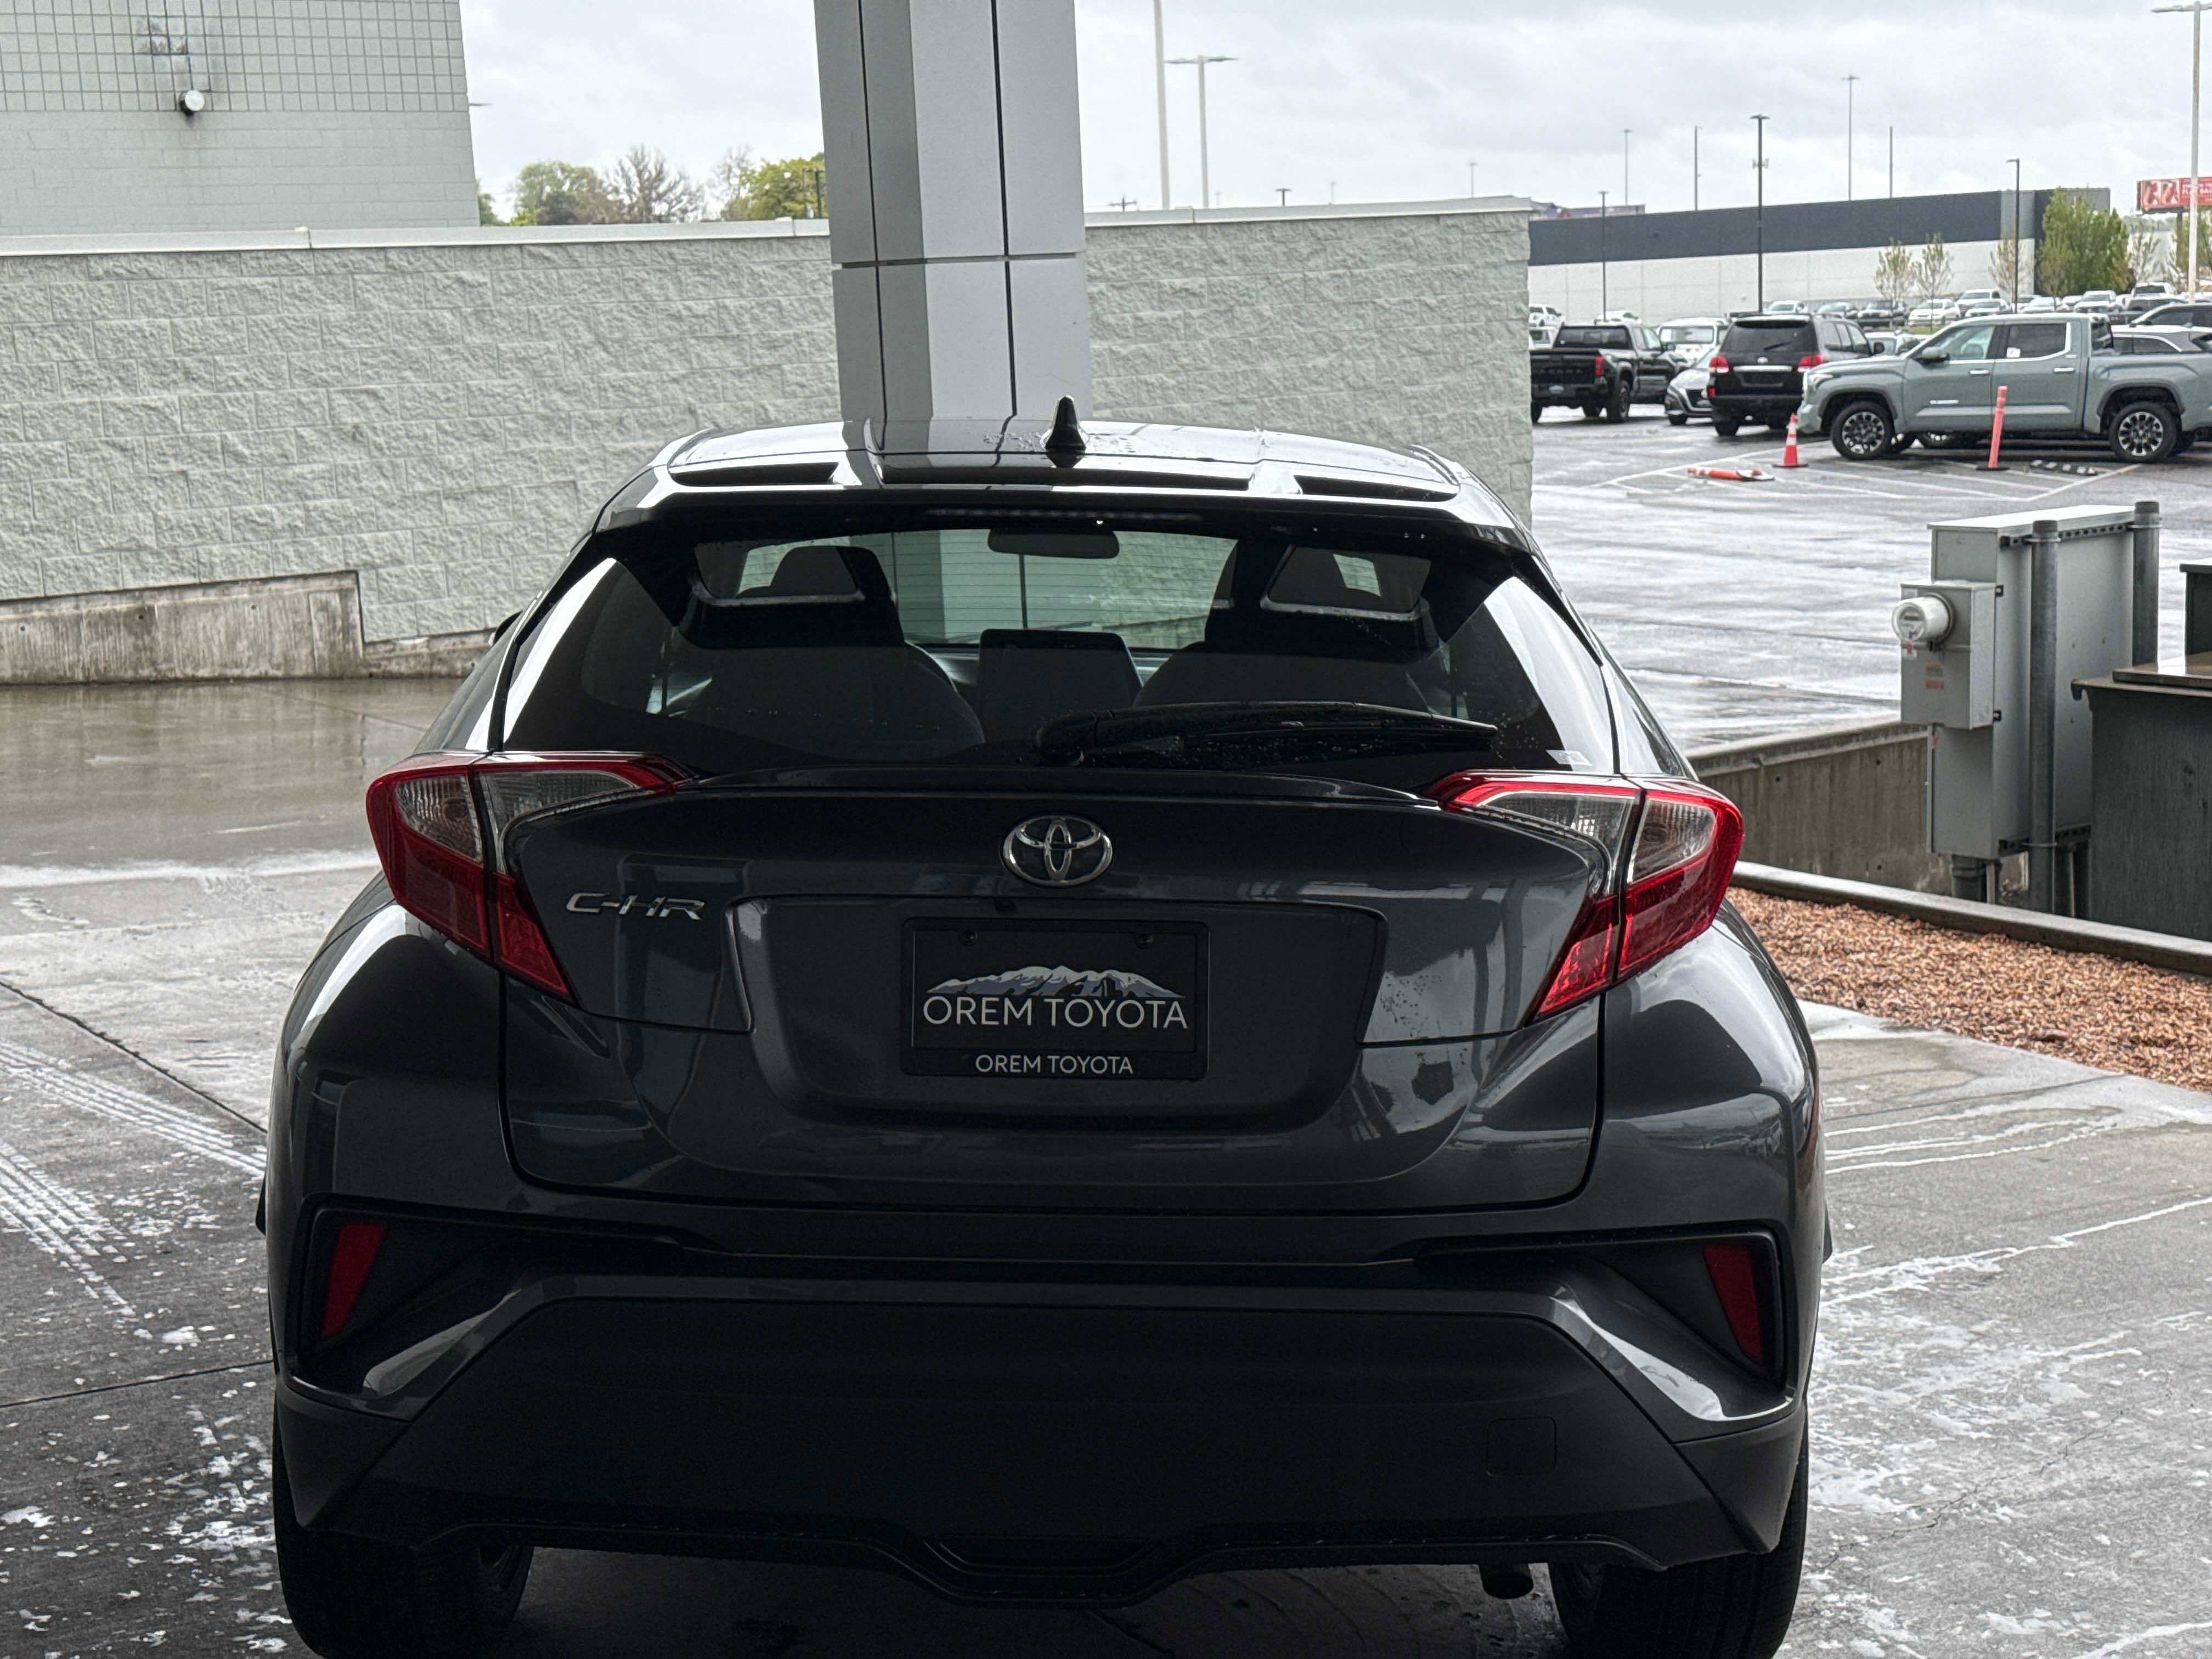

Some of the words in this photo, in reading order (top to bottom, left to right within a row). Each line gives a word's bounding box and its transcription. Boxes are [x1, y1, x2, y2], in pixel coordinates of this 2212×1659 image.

[566, 892, 704, 921] C-HR
[923, 996, 1032, 1025] OREM
[1044, 998, 1188, 1029] TOYOTA
[975, 1054, 1041, 1073] OREM
[1047, 1056, 1133, 1074] TOYOTA
